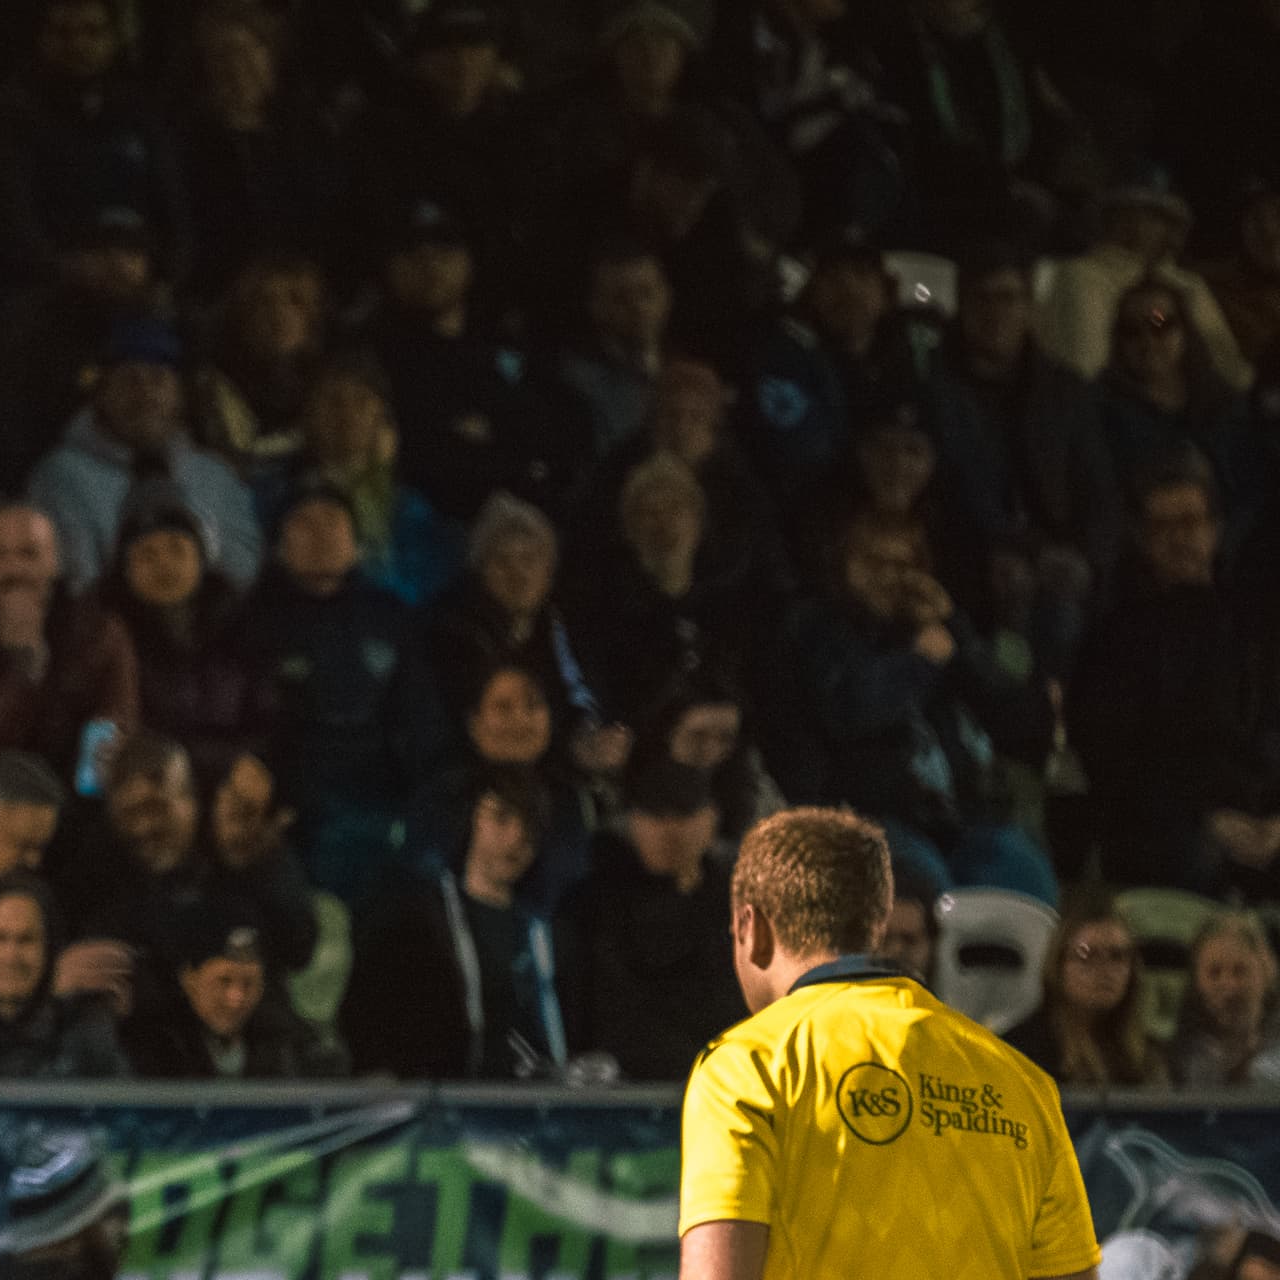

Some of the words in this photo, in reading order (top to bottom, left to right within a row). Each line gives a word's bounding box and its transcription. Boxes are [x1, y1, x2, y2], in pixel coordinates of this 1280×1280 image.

[848, 1087, 902, 1117] K&S
[919, 1073, 979, 1113] King
[981, 1084, 1004, 1110] &
[919, 1101, 1029, 1150] Spalding
